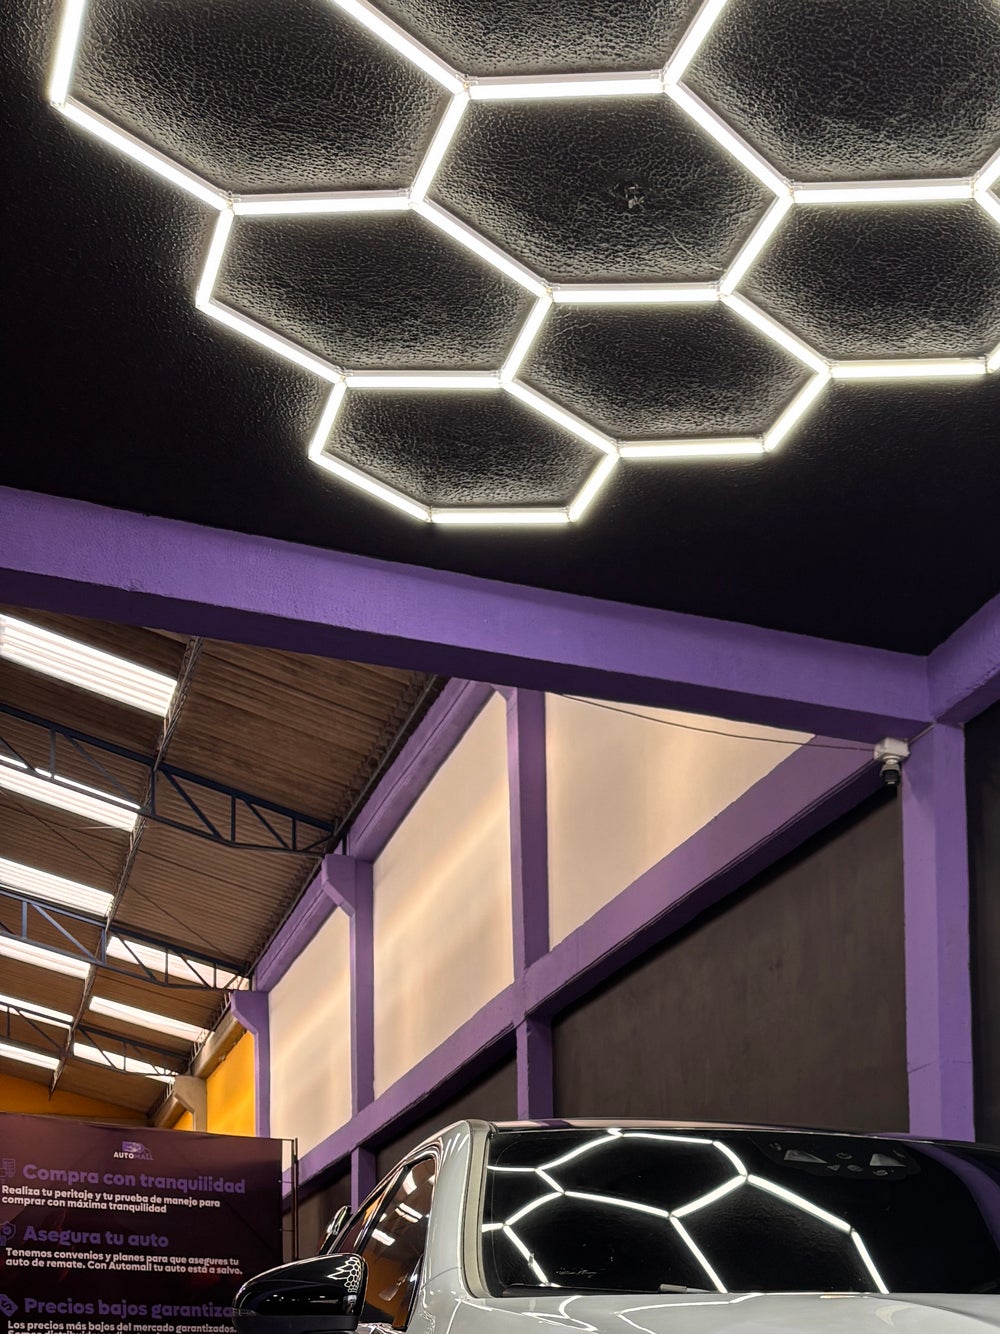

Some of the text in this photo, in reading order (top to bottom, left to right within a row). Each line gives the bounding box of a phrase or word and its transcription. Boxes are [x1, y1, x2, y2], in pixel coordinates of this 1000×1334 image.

[22, 1163, 246, 1194] Compra con tranquilidad
[1, 1184, 221, 1208] Realiza tu peritaje y tu prueba de manejo para
[1, 1196, 167, 1214] comprar con máxima tranquilidad
[23, 1225, 169, 1248] Asegura tu auto
[5, 1247, 239, 1267] Tenemos convenios y planes para que asegures tu
[5, 1258, 30, 1267] auto
[31, 1258, 45, 1267] de
[46, 1260, 86, 1269] remate.
[87, 1260, 107, 1270] Con
[108, 1261, 152, 1272] Automall
[153, 1264, 164, 1272] tu
[164, 1264, 187, 1273] auto
[187, 1264, 207, 1274] está
[216, 1265, 244, 1275] salvo.
[24, 1297, 233, 1320] Precios bajos garantiza
[7, 1320, 237, 1334] Los precios más bajos del mercado garantizados.
